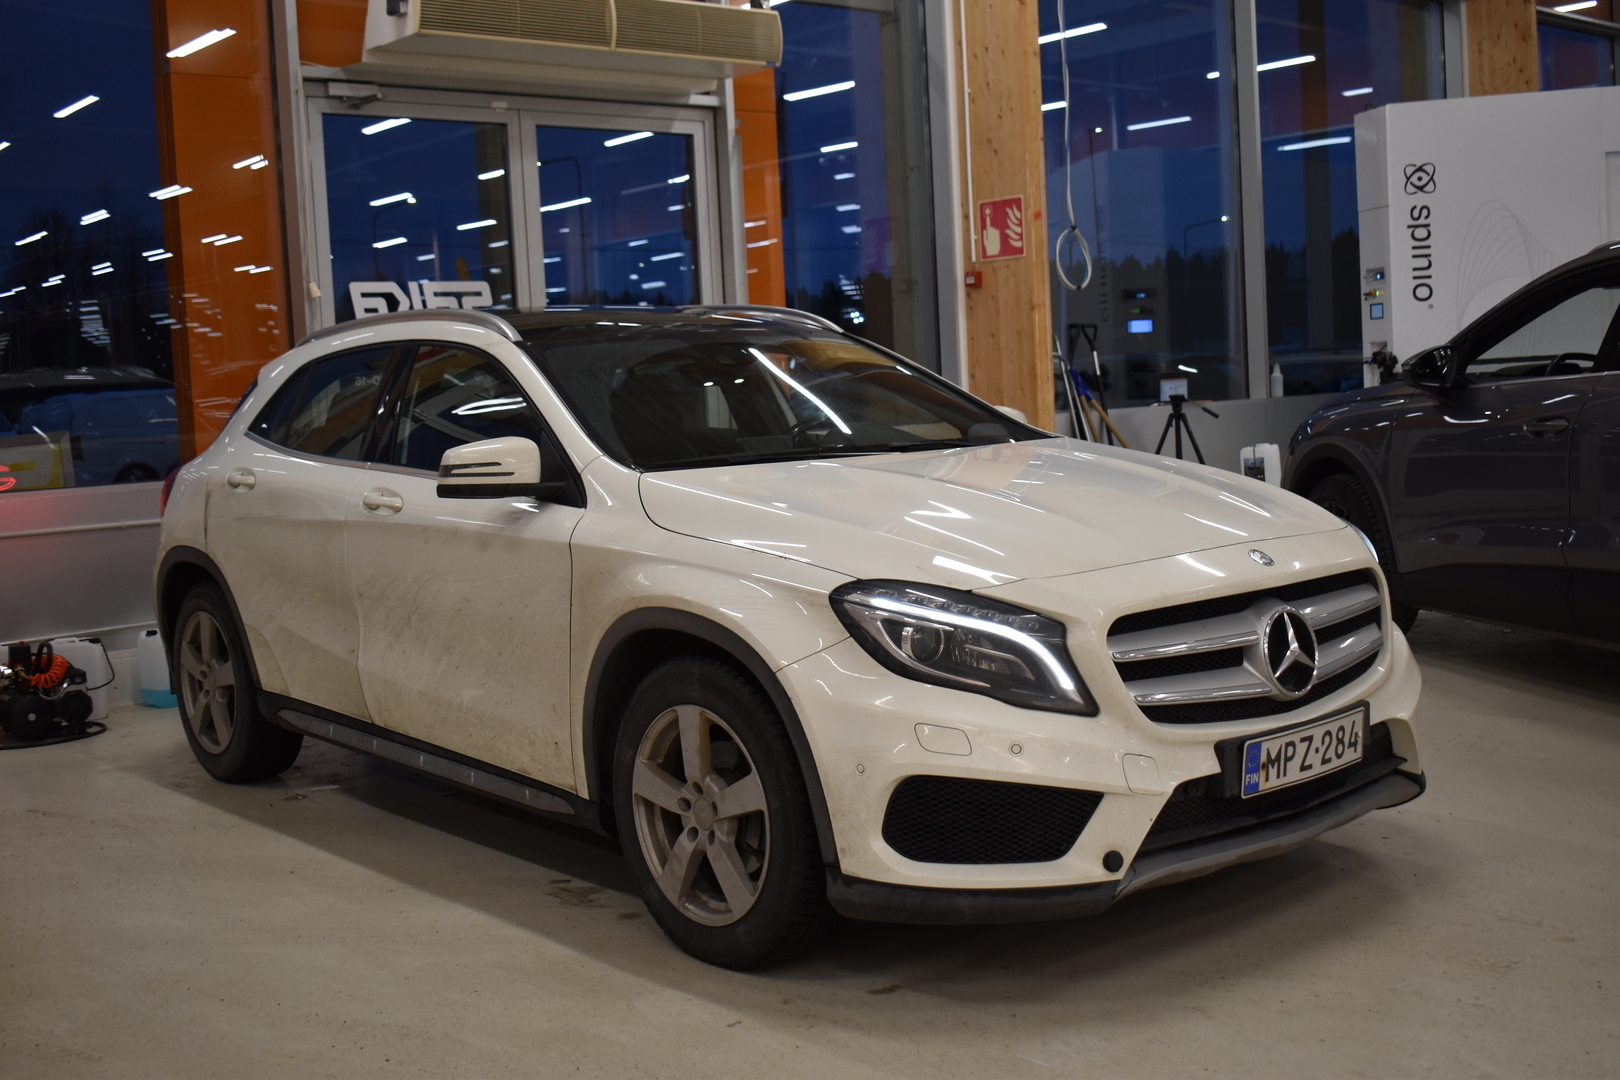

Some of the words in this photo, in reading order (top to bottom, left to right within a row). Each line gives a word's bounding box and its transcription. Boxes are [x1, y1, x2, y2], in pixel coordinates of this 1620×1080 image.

[1406, 204, 1434, 303] spinio
[1245, 771, 1259, 786] FIN
[1264, 719, 1359, 783] MPZ-284
